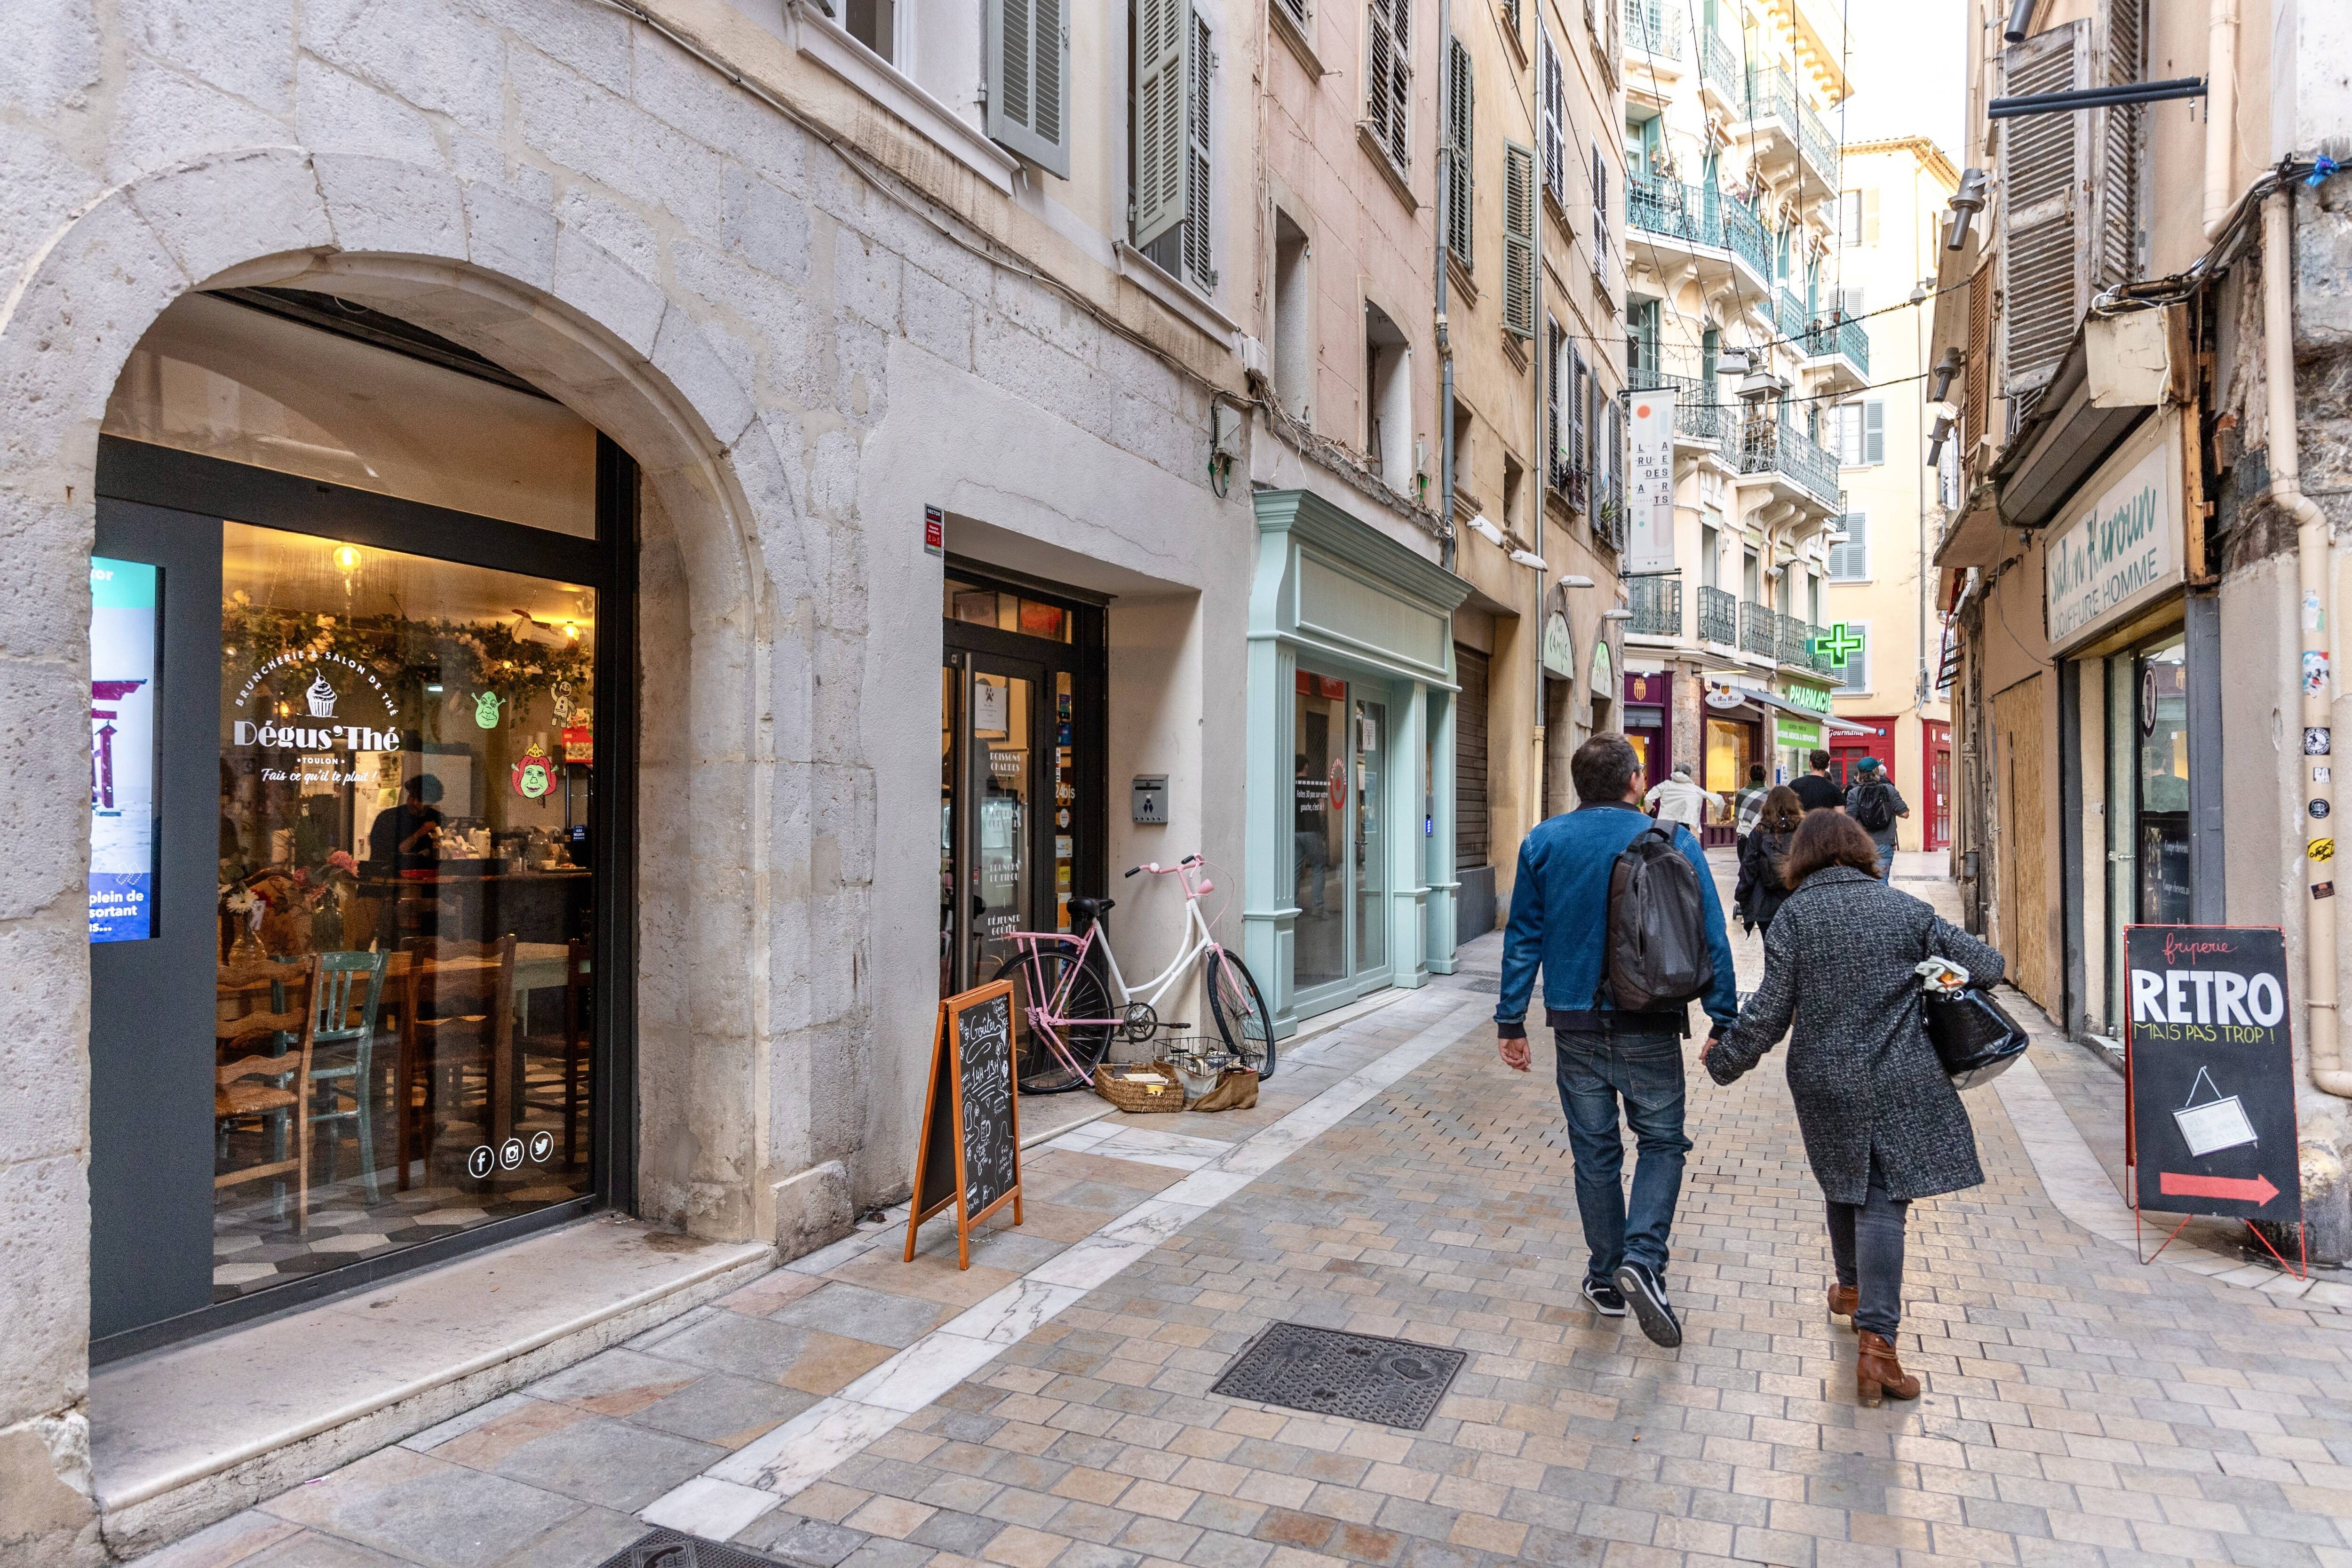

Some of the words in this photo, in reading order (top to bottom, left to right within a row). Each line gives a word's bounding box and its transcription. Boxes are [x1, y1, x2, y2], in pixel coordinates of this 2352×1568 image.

[1646, 469, 1668, 478] DES
[927, 508, 940, 517] SECTOR
[2054, 588, 2100, 639] COIFFURE
[2102, 547, 2158, 610] HOMME
[235, 651, 304, 707] BRUNCHERIE
[311, 650, 319, 659] &
[325, 651, 366, 675] SALON
[368, 675, 382, 690] DE
[381, 692, 399, 716] THÉ
[1789, 685, 1832, 713] PHARMACIE
[234, 720, 400, 752] Dégus'Thé
[990, 752, 1020, 762] BOISSONS
[990, 762, 1020, 772] CHAUDES
[261, 768, 287, 782] Fais
[290, 773, 302, 781] ce
[304, 769, 329, 785] qu'il
[331, 770, 342, 782] te
[1296, 790, 1306, 798] Faites
[89, 890, 123, 907] plein
[126, 889, 144, 902] de
[89, 905, 138, 918] sortant
[988, 914, 1021, 926] DÉJEUNER
[2162, 932, 2239, 965] friperie
[2131, 969, 2284, 1027] RETRO
[2186, 1023, 2217, 1042] PAS
[2221, 1025, 2264, 1043] TROP
